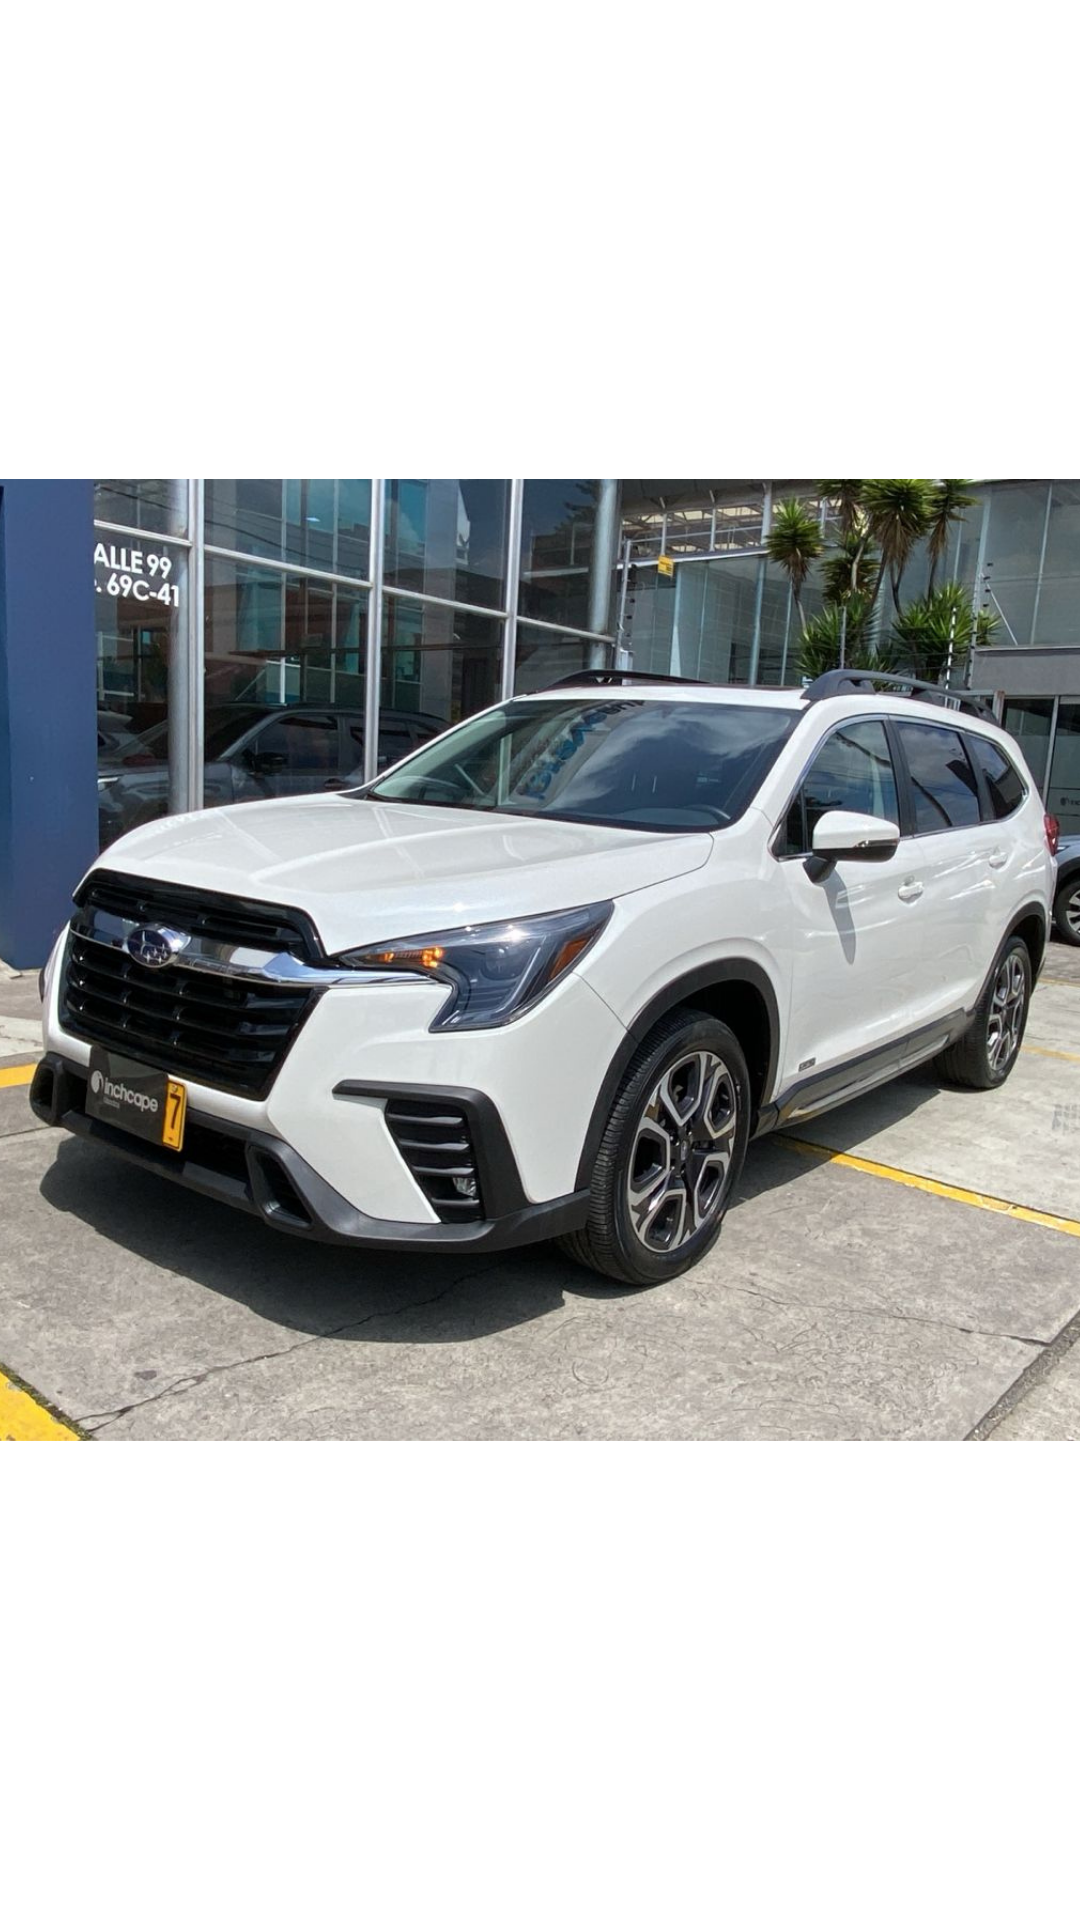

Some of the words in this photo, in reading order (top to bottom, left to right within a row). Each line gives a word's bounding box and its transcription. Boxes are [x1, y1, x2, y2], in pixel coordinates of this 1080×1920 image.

[147, 554, 172, 579] 99
[107, 573, 179, 607] 69C-41
[104, 1077, 158, 1112] inchcape
[170, 1093, 181, 1129] 7
